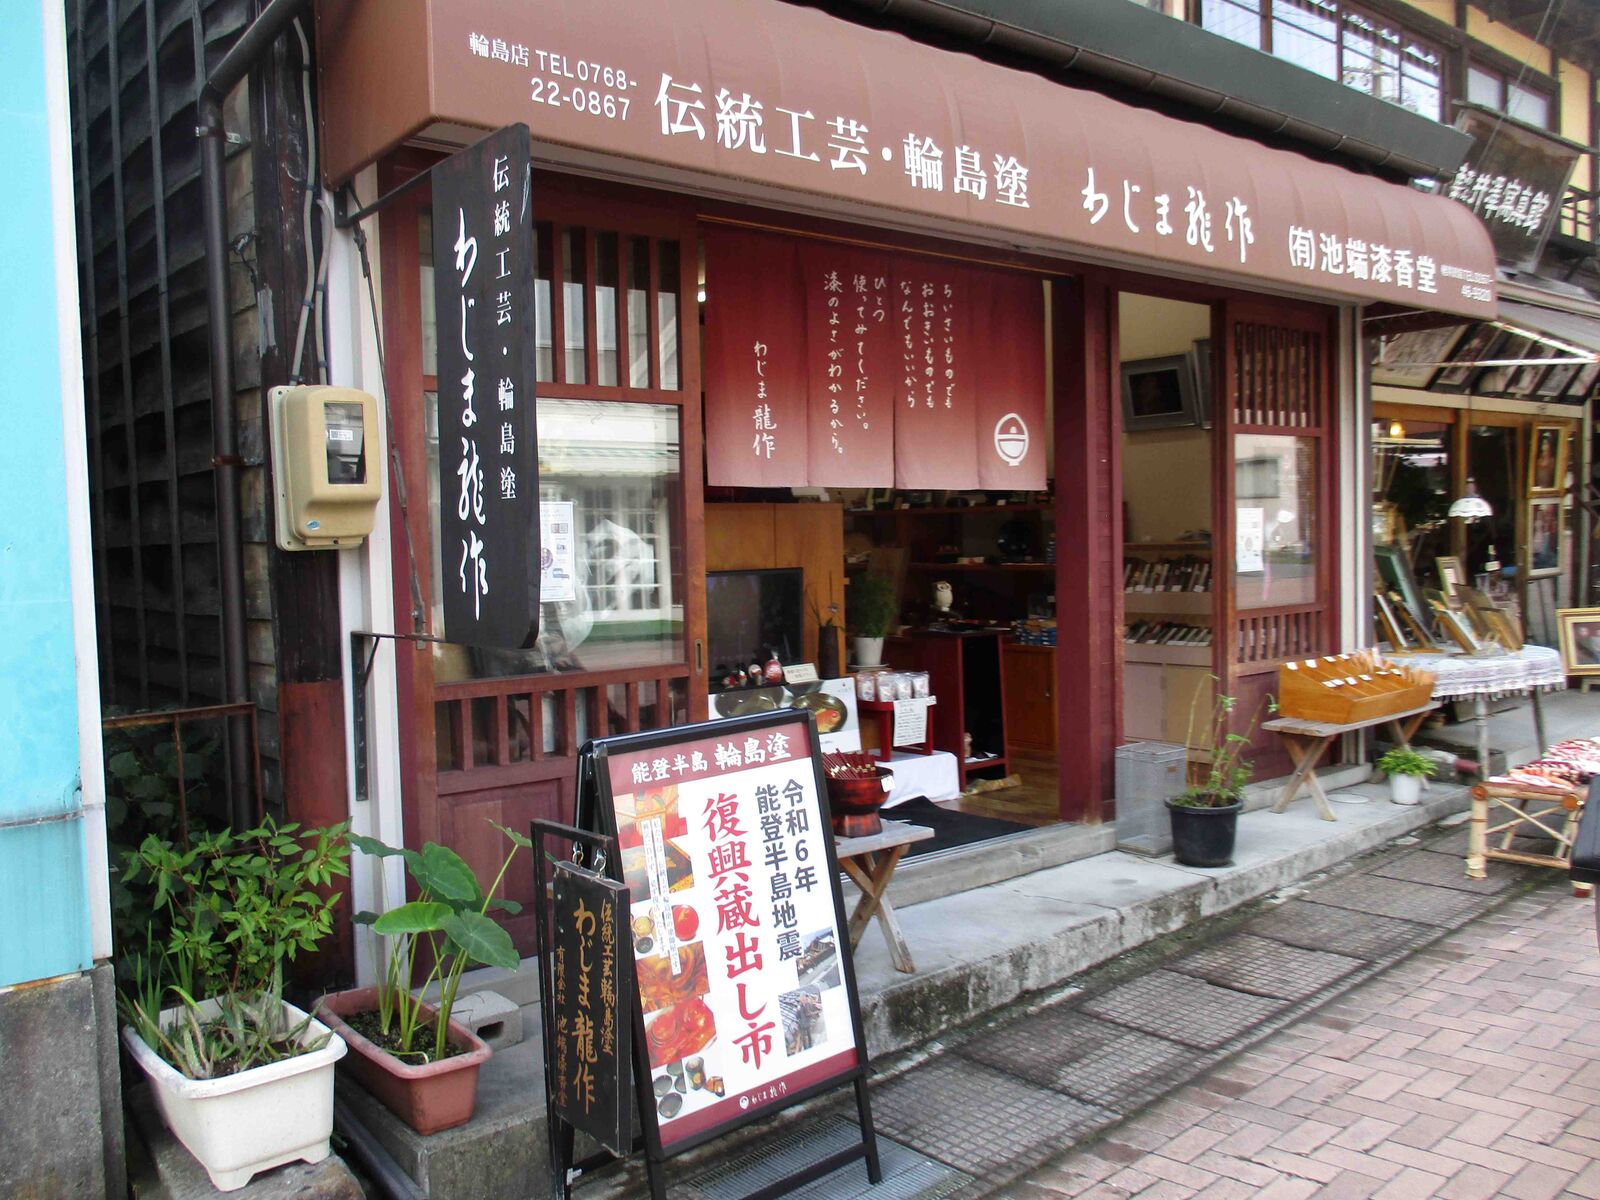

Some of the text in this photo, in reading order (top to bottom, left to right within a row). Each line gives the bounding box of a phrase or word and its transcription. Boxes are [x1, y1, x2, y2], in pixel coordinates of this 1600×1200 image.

[469, 32, 529, 68] 輪島店
[531, 77, 630, 120] 22-0867
[654, 73, 1031, 209] 伝統工芸・輪島塗
[493, 155, 516, 500] 伝統工芸・輪島塗
[824, 271, 844, 454] 漆のよさがわかるから。
[853, 273, 869, 430] 使ってみてください。
[873, 277, 887, 322] ひとつ
[900, 281, 917, 408] なんでもいいから
[921, 283, 935, 409] おおきいものでも
[943, 284, 956, 409] ちいさいものでも
[753, 340, 777, 459] わじま龍作
[631, 732, 792, 785] 能登半島 輪島塗
[755, 784, 802, 962] 能登半島地震
[782, 778, 818, 894] 令和6年
[702, 792, 776, 1070] 復興蔵出し市
[572, 897, 598, 1115] わじま龍作
